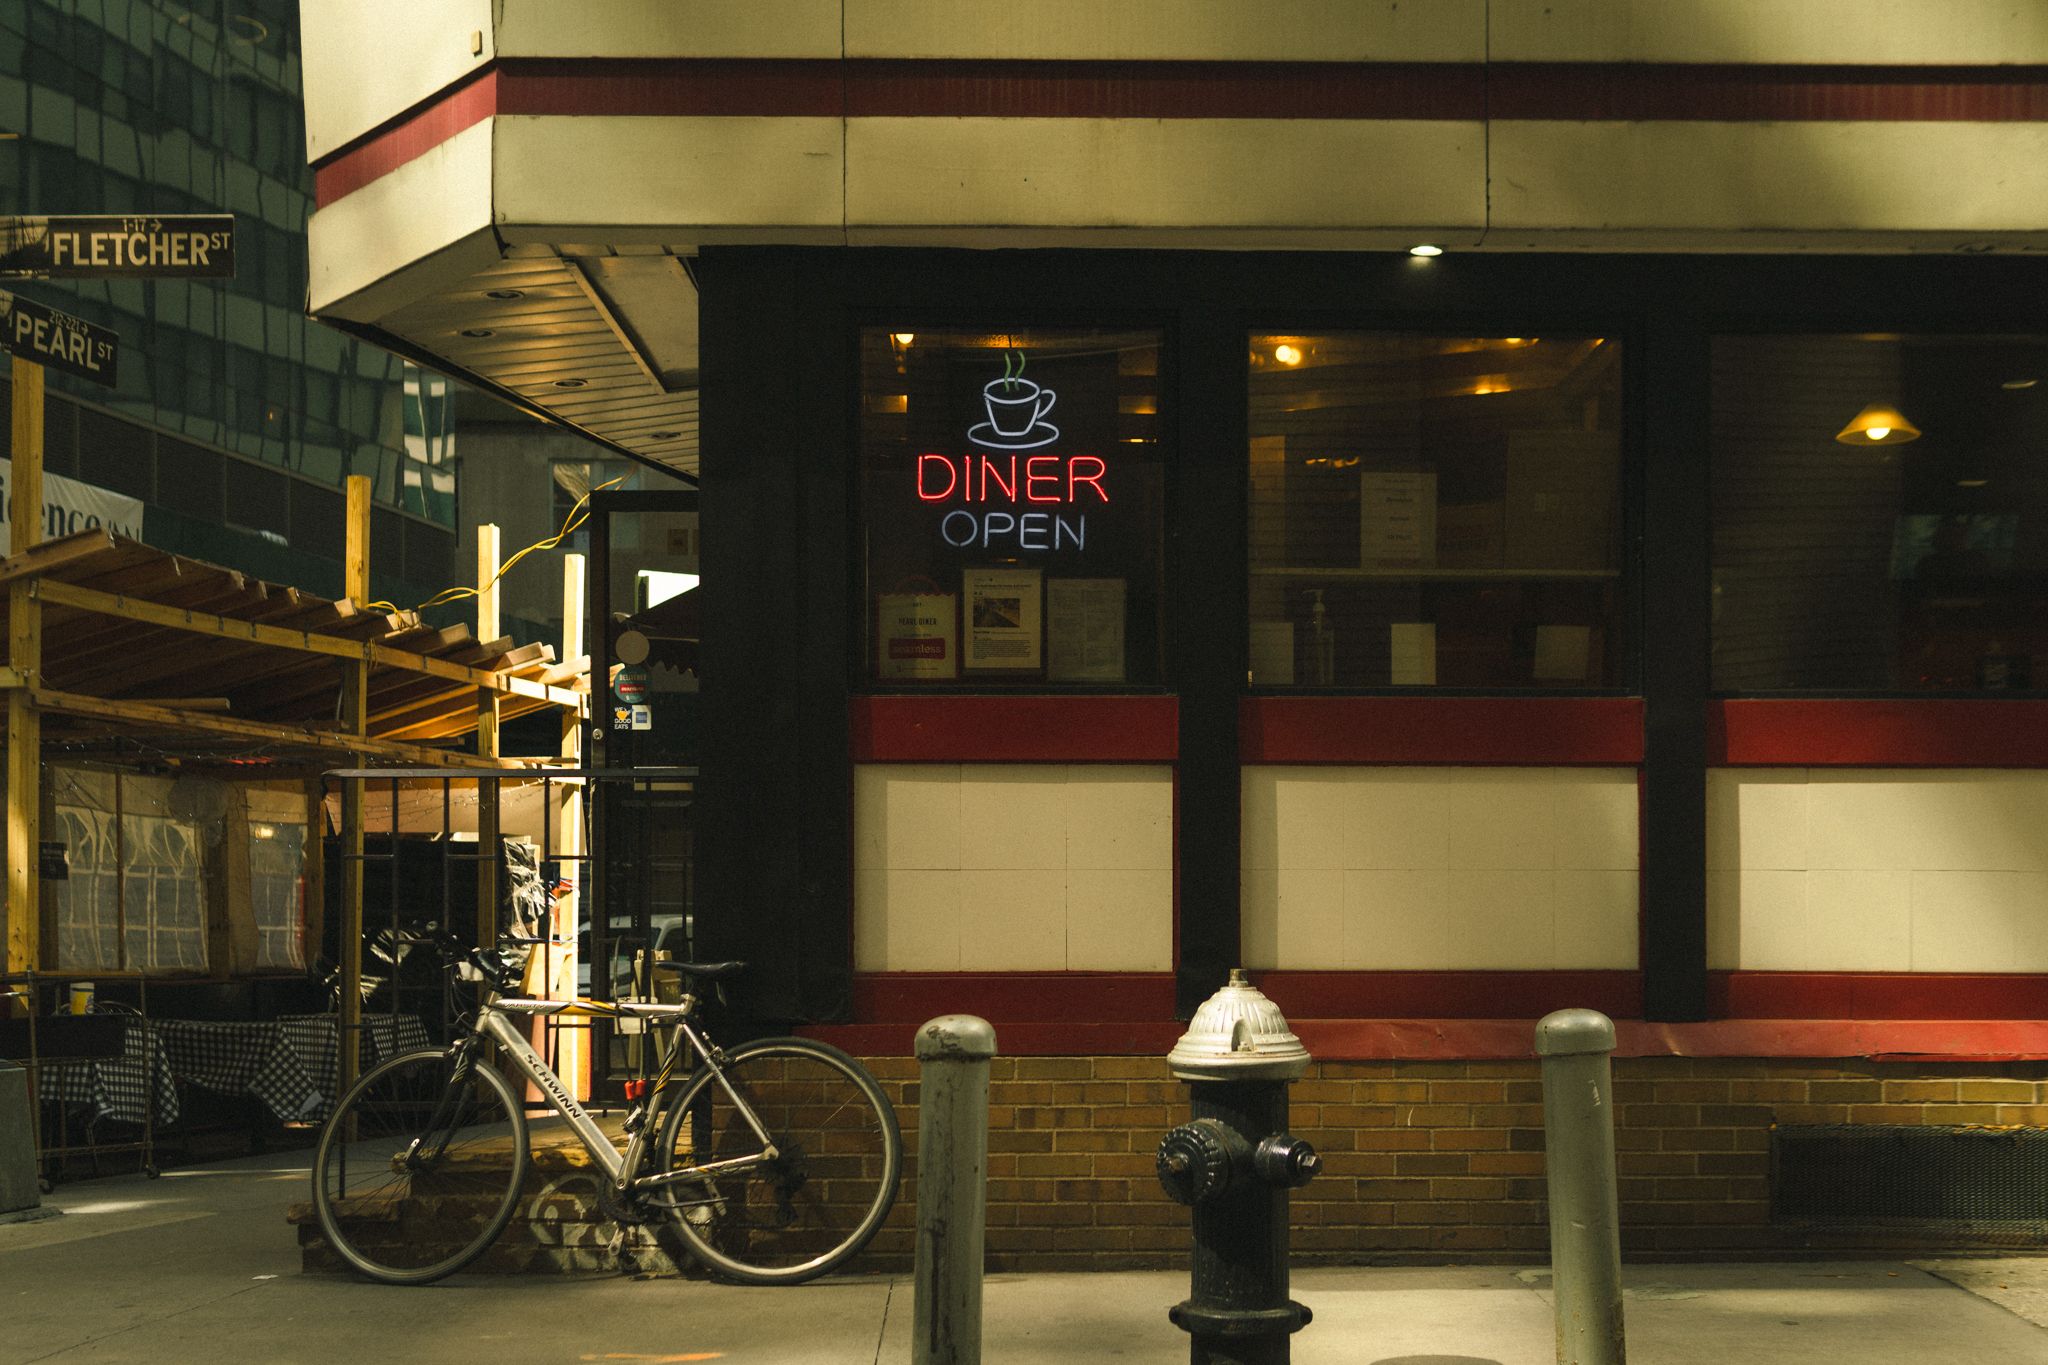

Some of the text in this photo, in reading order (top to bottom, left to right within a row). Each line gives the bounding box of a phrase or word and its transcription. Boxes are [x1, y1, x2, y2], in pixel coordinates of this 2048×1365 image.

[123, 219, 146, 232] 1-17
[53, 232, 231, 266] FLETCHER ST
[15, 310, 113, 371] PEARL ST
[917, 454, 1109, 503] DINER
[941, 510, 1085, 551] OPEN
[524, 1053, 581, 1120] SCHWINN
